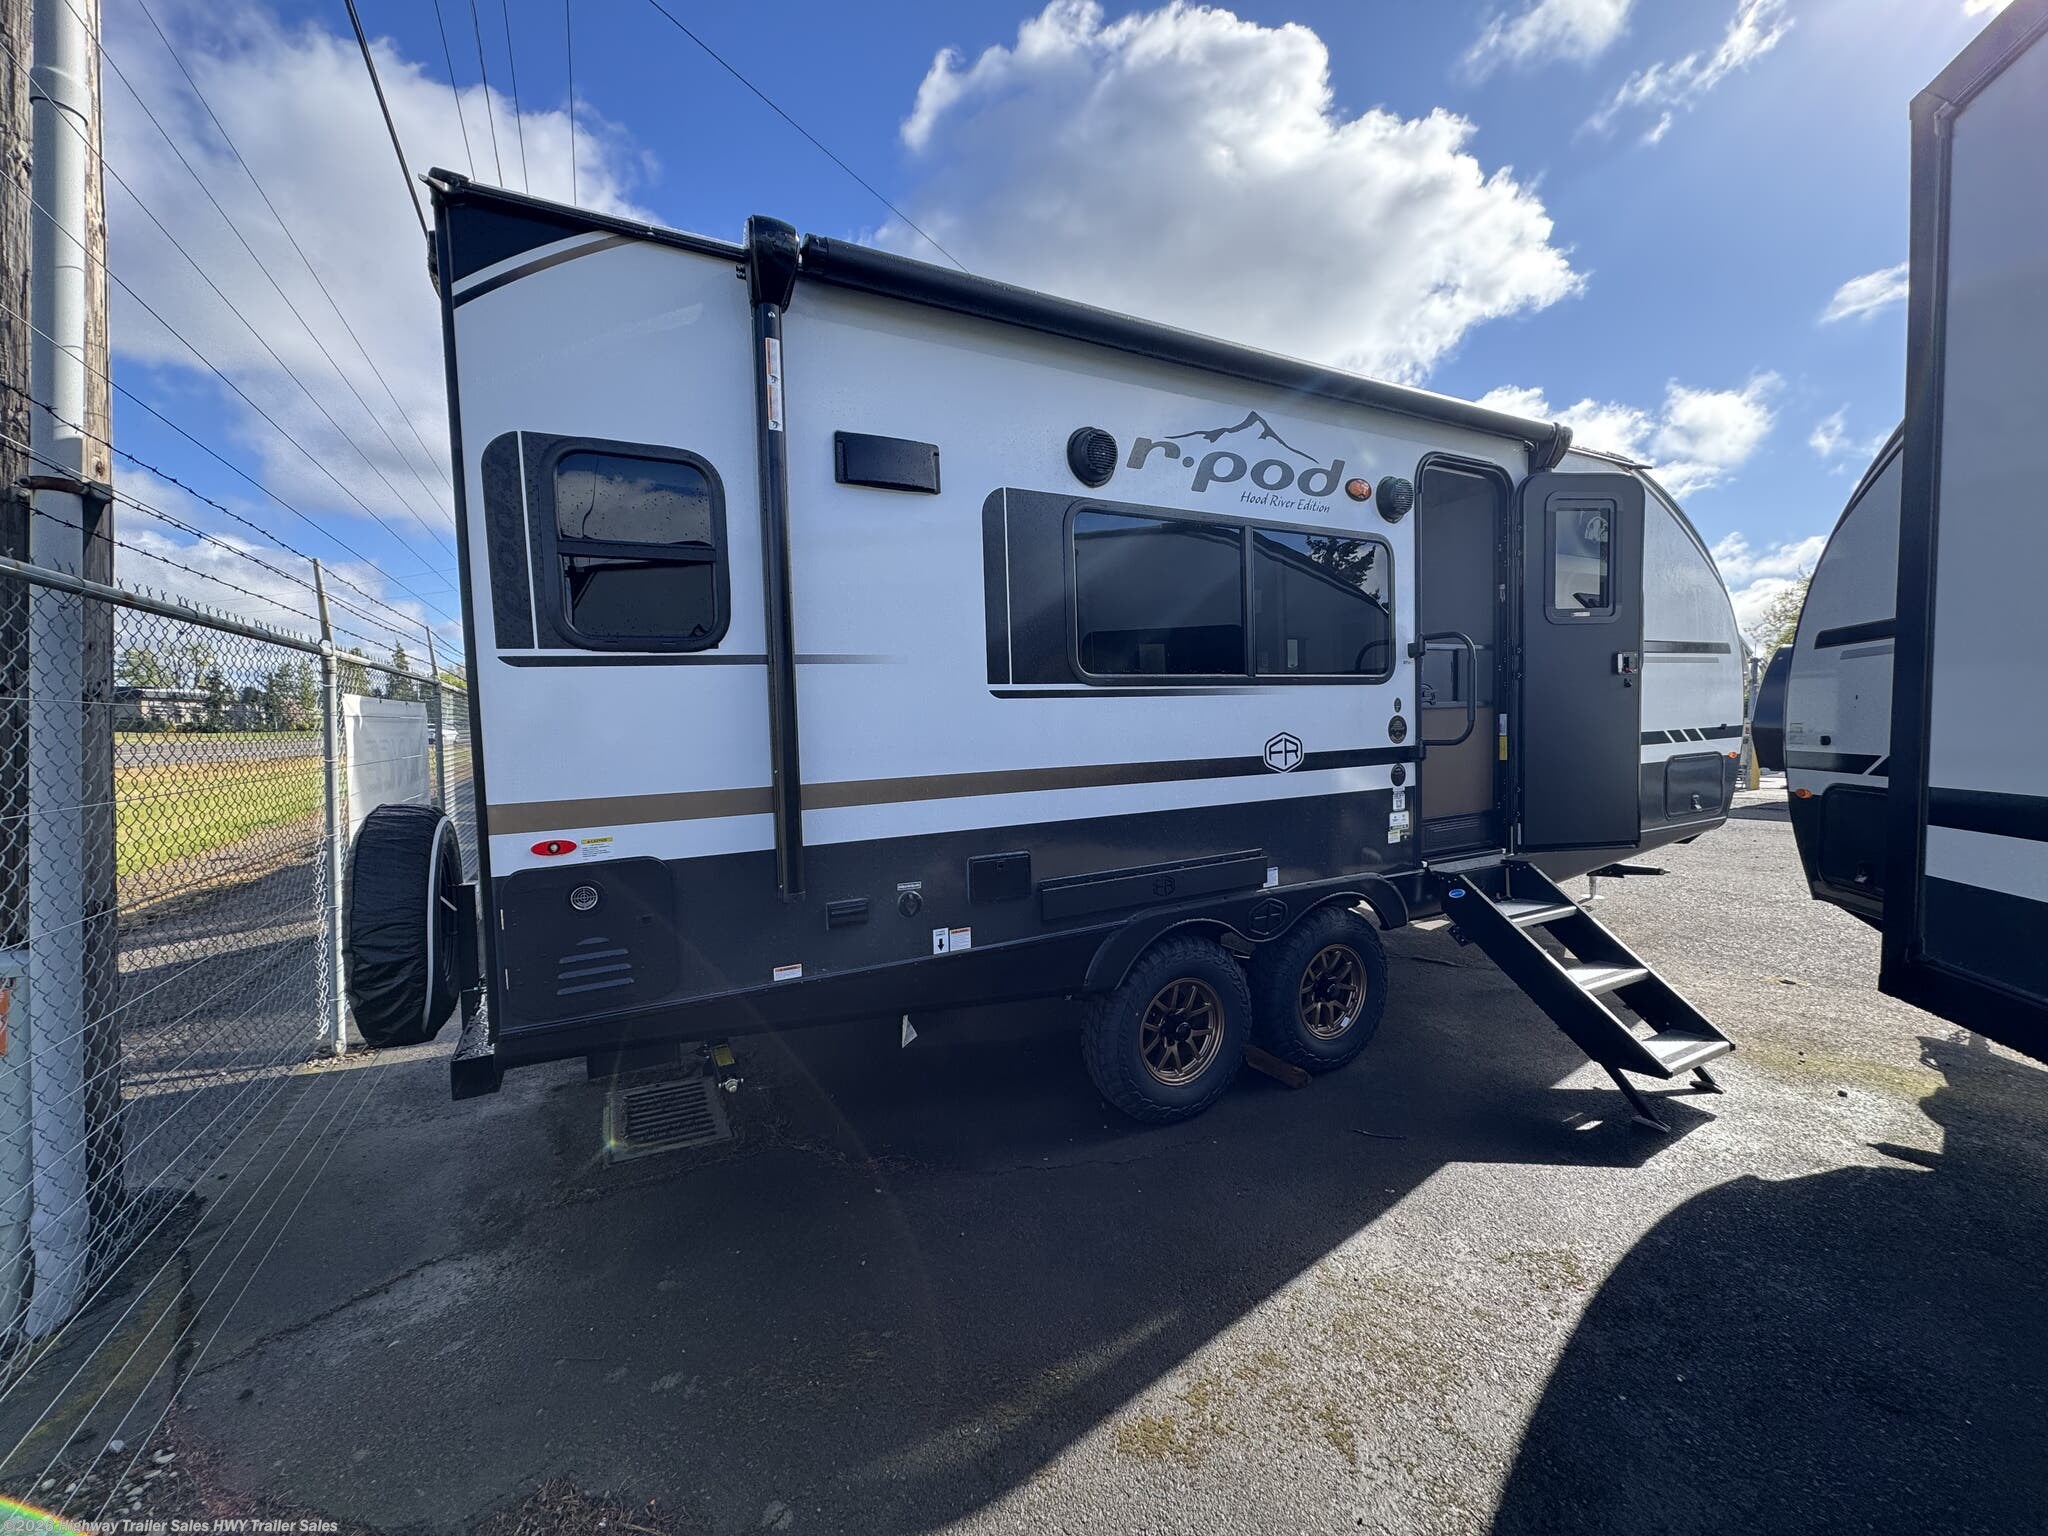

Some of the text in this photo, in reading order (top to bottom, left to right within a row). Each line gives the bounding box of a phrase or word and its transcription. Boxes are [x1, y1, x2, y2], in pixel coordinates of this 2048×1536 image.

[1240, 491, 1330, 513] Hood River Edition
